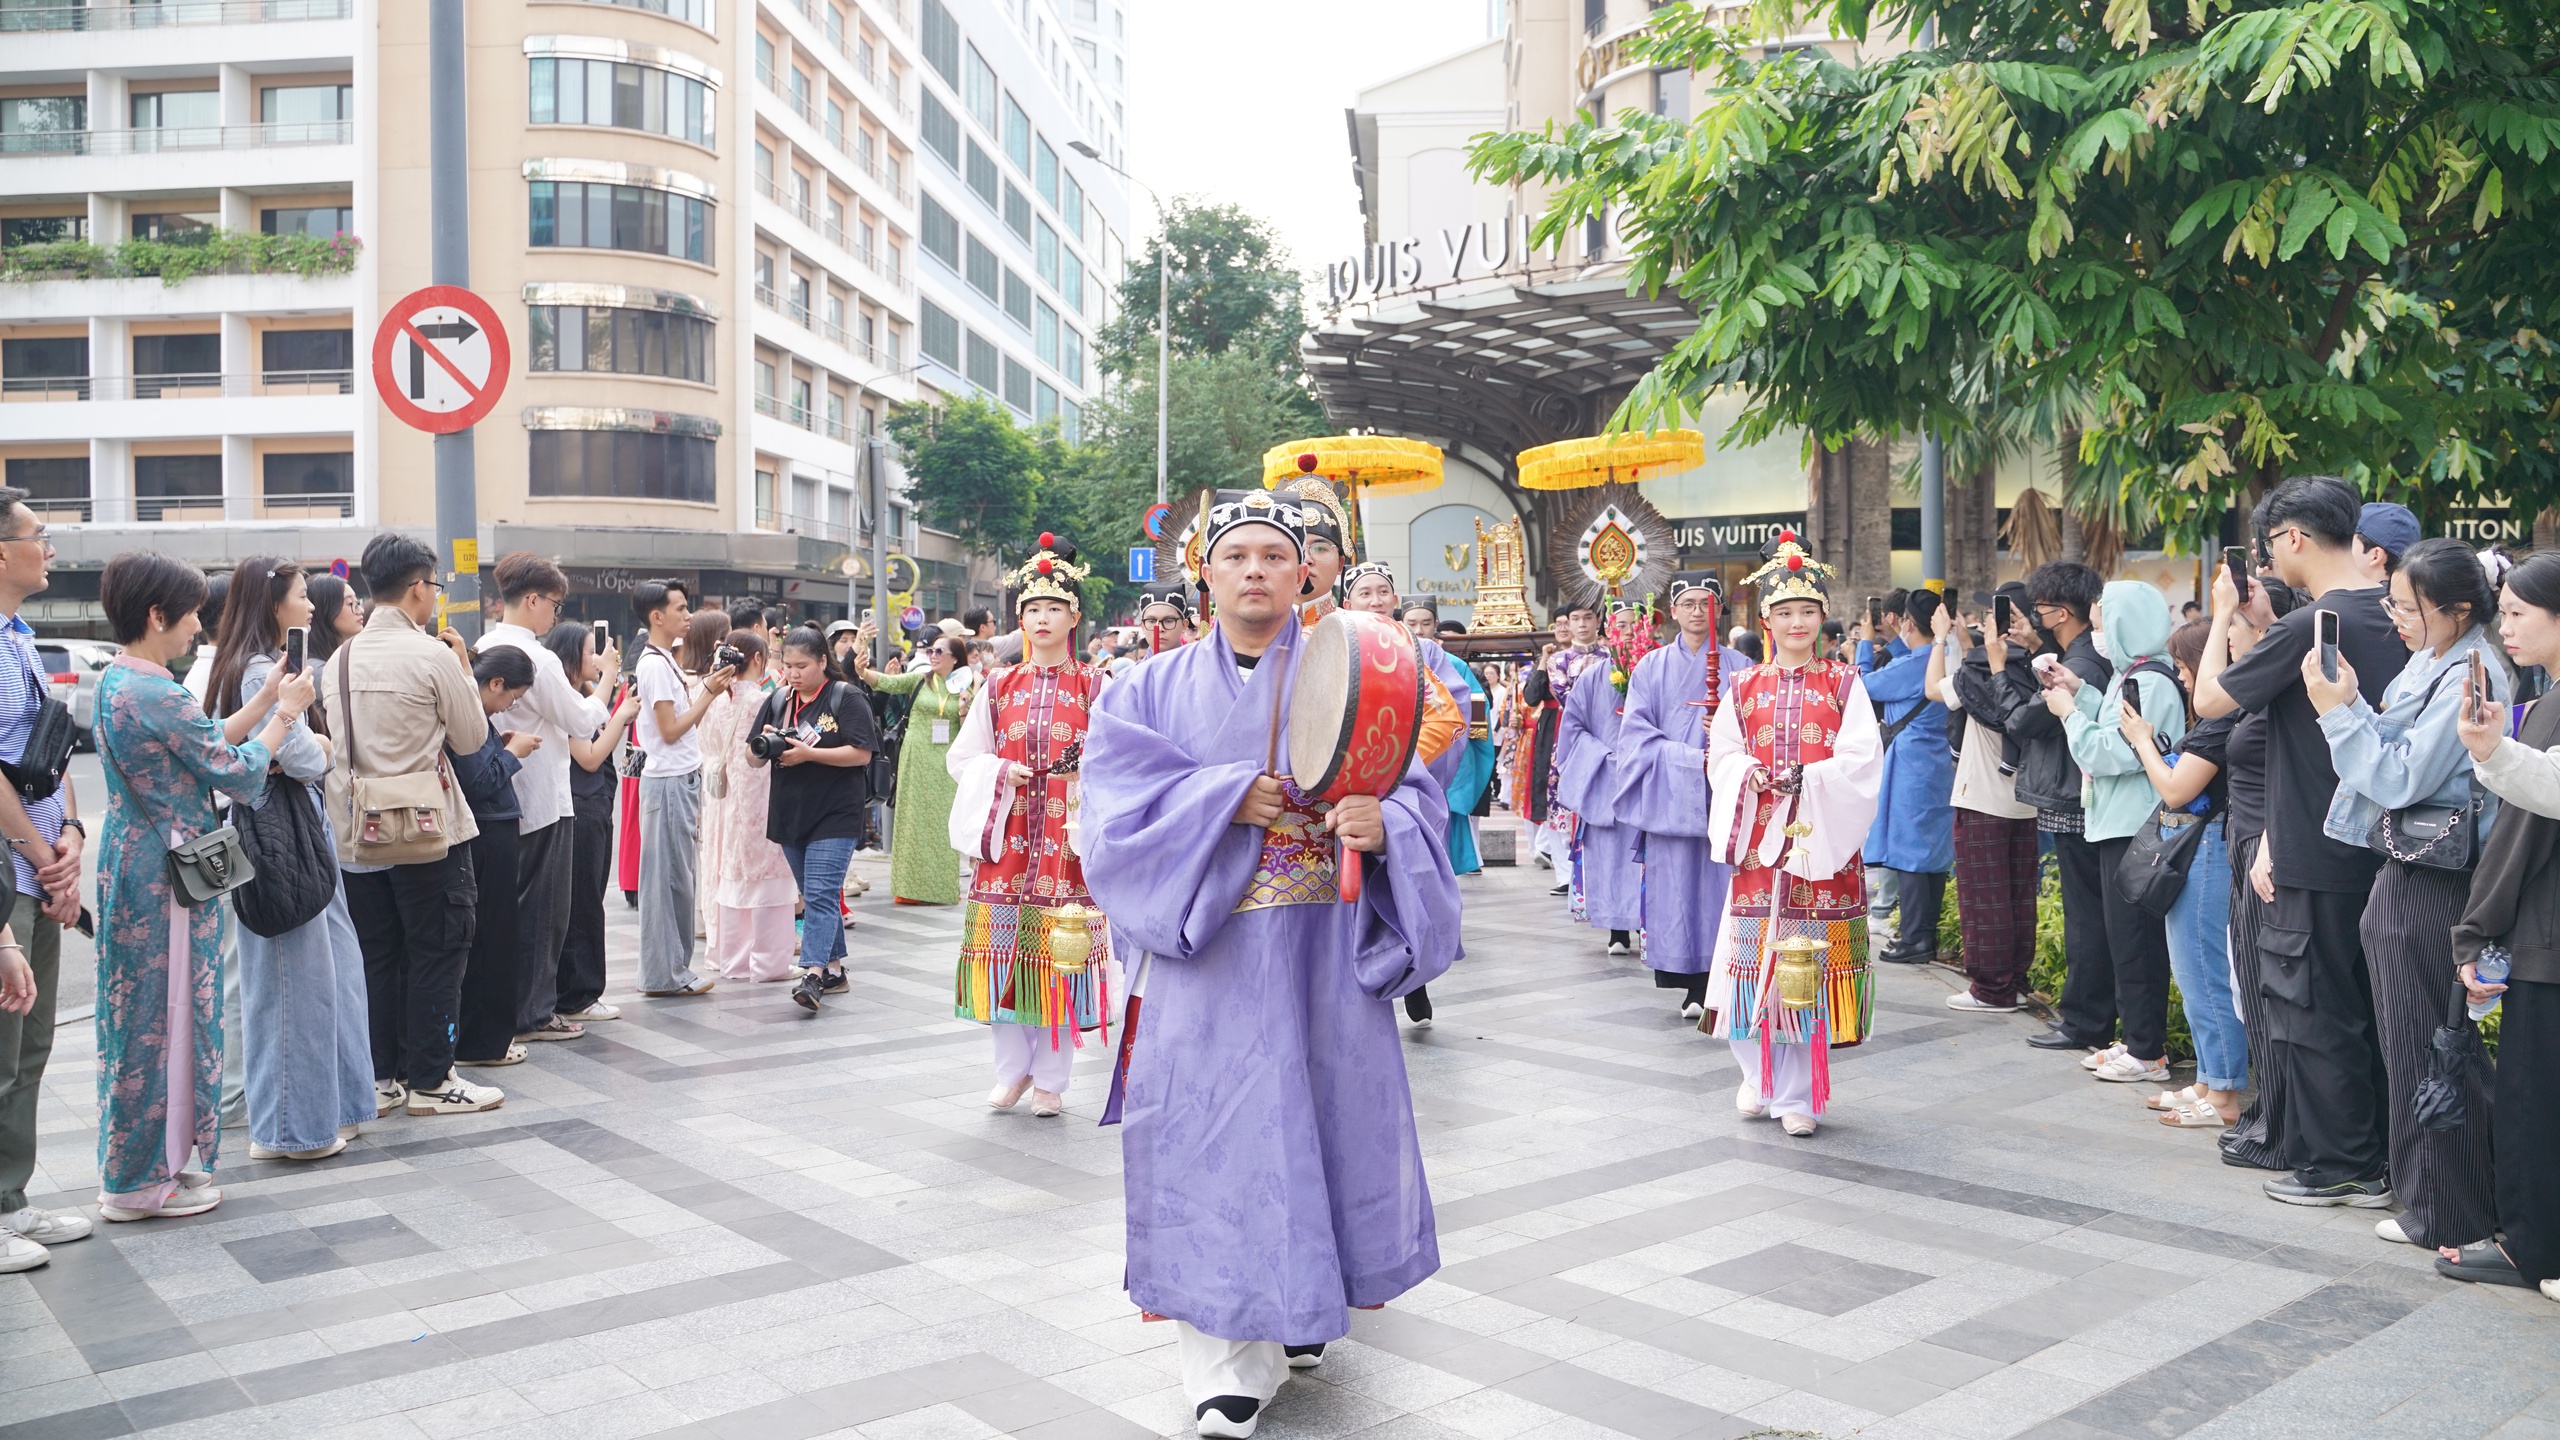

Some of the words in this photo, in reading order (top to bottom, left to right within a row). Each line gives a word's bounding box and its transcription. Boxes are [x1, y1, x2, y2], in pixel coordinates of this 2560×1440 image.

[1438, 200, 1656, 279] VUITTO
[1673, 527, 1705, 548] UIS
[2444, 519, 2521, 540] ITTON
[1416, 577, 1461, 593] OPERA
[1461, 578, 1477, 592] VI
